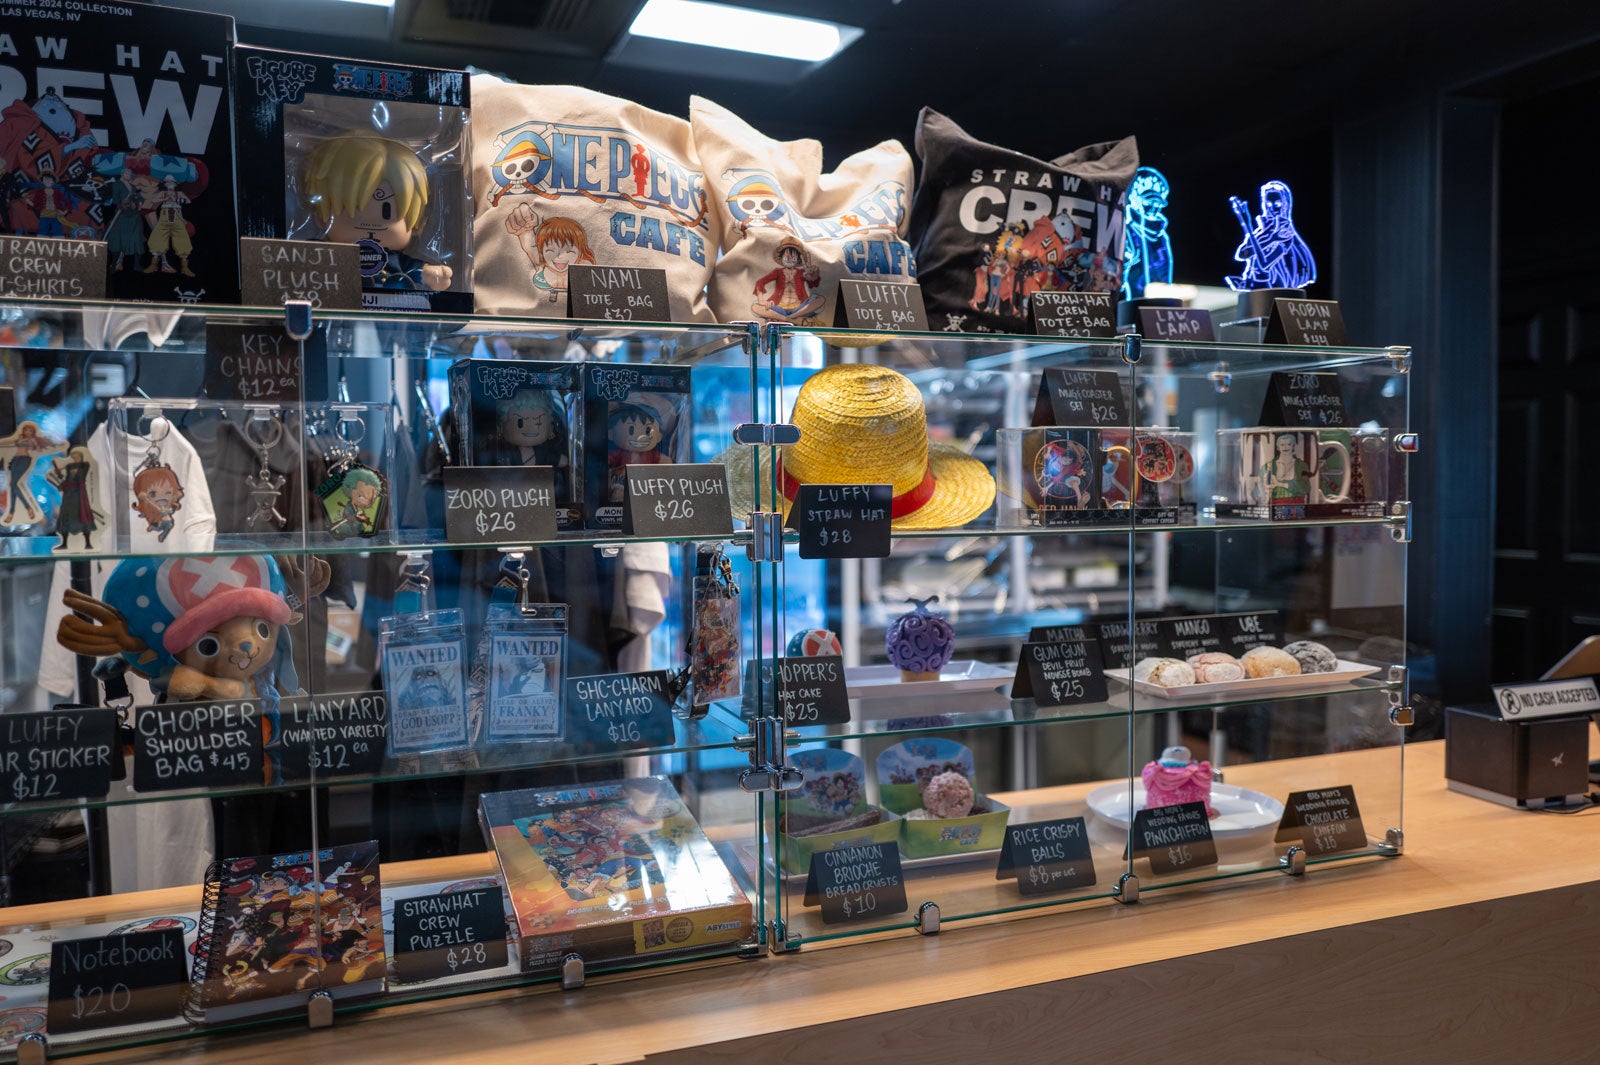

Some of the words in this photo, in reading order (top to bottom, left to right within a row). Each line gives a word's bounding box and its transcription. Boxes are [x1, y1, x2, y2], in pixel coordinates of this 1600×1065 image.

[2, 7, 21, 16] LAS
[25, 9, 64, 21] VEGAS,
[67, 13, 81, 21] NV
[65, 1, 133, 16] COLLECTION
[116, 44, 223, 77] HAT
[247, 56, 317, 83] FIGURE
[256, 76, 304, 102] KEY
[491, 131, 602, 195] ONE
[609, 138, 708, 215] PIECE
[970, 169, 1083, 193] STRAW
[1101, 185, 1127, 207] HA
[610, 211, 707, 267] CAFE
[9, 256, 62, 274] CREW
[261, 246, 337, 266] SANJI
[842, 240, 917, 278] CAFE
[0, 276, 83, 297] T-SHIRTS
[263, 270, 339, 291] PLUSH
[590, 269, 643, 290] NAMI
[583, 294, 612, 306] TOTE
[628, 296, 653, 308] BAG
[855, 284, 908, 308] LUFFY
[855, 308, 883, 321] TOTE
[892, 310, 915, 323] BAG
[1056, 306, 1089, 316] CREW
[1156, 309, 1189, 322] LAW
[1287, 302, 1331, 318] ROBIN
[1156, 321, 1200, 336] LAMP
[1296, 318, 1329, 331] LAMP
[241, 334, 283, 355] KEY
[1303, 333, 1330, 346] $44
[221, 355, 304, 377] CHAINS
[477, 366, 527, 383] FIGURE
[591, 368, 639, 385] FIGURE
[238, 378, 280, 399] $12
[1062, 371, 1098, 387] LUFFY
[1287, 374, 1319, 389] ZORO
[484, 381, 518, 399] KEY
[597, 382, 630, 400] KEY
[1092, 402, 1118, 422] $26
[1319, 411, 1343, 424] $26
[630, 478, 675, 496] LUFFY
[679, 478, 724, 496] PLUSH
[818, 486, 870, 502] LUFFY
[447, 488, 497, 510] ZORO
[501, 488, 551, 508] PLUSH
[655, 499, 694, 522] $26
[808, 508, 852, 522] STRAW
[861, 508, 886, 521] HAT
[475, 509, 516, 536] $26
[819, 527, 852, 547] $28
[1101, 622, 1158, 639] STRAWERRY
[1175, 619, 1210, 636] MANGO
[1239, 615, 1263, 633] UBE
[391, 646, 459, 667] WANTED
[497, 640, 559, 656] WANTED
[1033, 646, 1060, 661] GUM
[1060, 643, 1087, 660] GUM
[576, 676, 662, 700] SHC-CHARM
[778, 690, 796, 700] HAT
[799, 688, 822, 699] CAKE
[1051, 680, 1084, 702] $25
[1520, 694, 1535, 709] NO
[1535, 690, 1557, 706] CASH
[1557, 687, 1598, 704] ACCEPTED
[138, 702, 257, 736] CHOPPER
[293, 695, 387, 724] LANYARD
[500, 705, 550, 717] FRANKY
[585, 696, 653, 722] LANYARD
[785, 702, 818, 721] $25
[8, 715, 85, 744] LUFFY
[401, 716, 425, 730] GOD
[426, 713, 455, 727] USOPP
[608, 721, 640, 743] $16
[146, 730, 251, 757] SHOULDER
[28, 745, 111, 772] STICKER
[155, 754, 204, 778] BAG
[210, 750, 251, 771] $45
[308, 744, 351, 769] $12
[353, 741, 370, 755] ea
[12, 772, 61, 800] $12
[1304, 808, 1350, 826] CHOCOLATE
[1012, 828, 1040, 847] RICE
[1043, 823, 1081, 841] CRISPY
[1313, 823, 1347, 838] CHIFFON
[824, 845, 883, 867] CINNAMON
[1031, 844, 1065, 863] BALLS
[834, 862, 882, 885] BRIOCHE
[1029, 866, 1049, 886] $8
[826, 883, 861, 899] BREAD
[862, 876, 898, 890] CRUSTS
[403, 891, 487, 917] STRAWHAT
[843, 892, 876, 917] $10
[419, 914, 460, 931] CREW
[410, 927, 475, 951] PUZZLE
[61, 933, 174, 974] Notebook
[447, 942, 487, 971] $28
[72, 983, 131, 1019] $20
